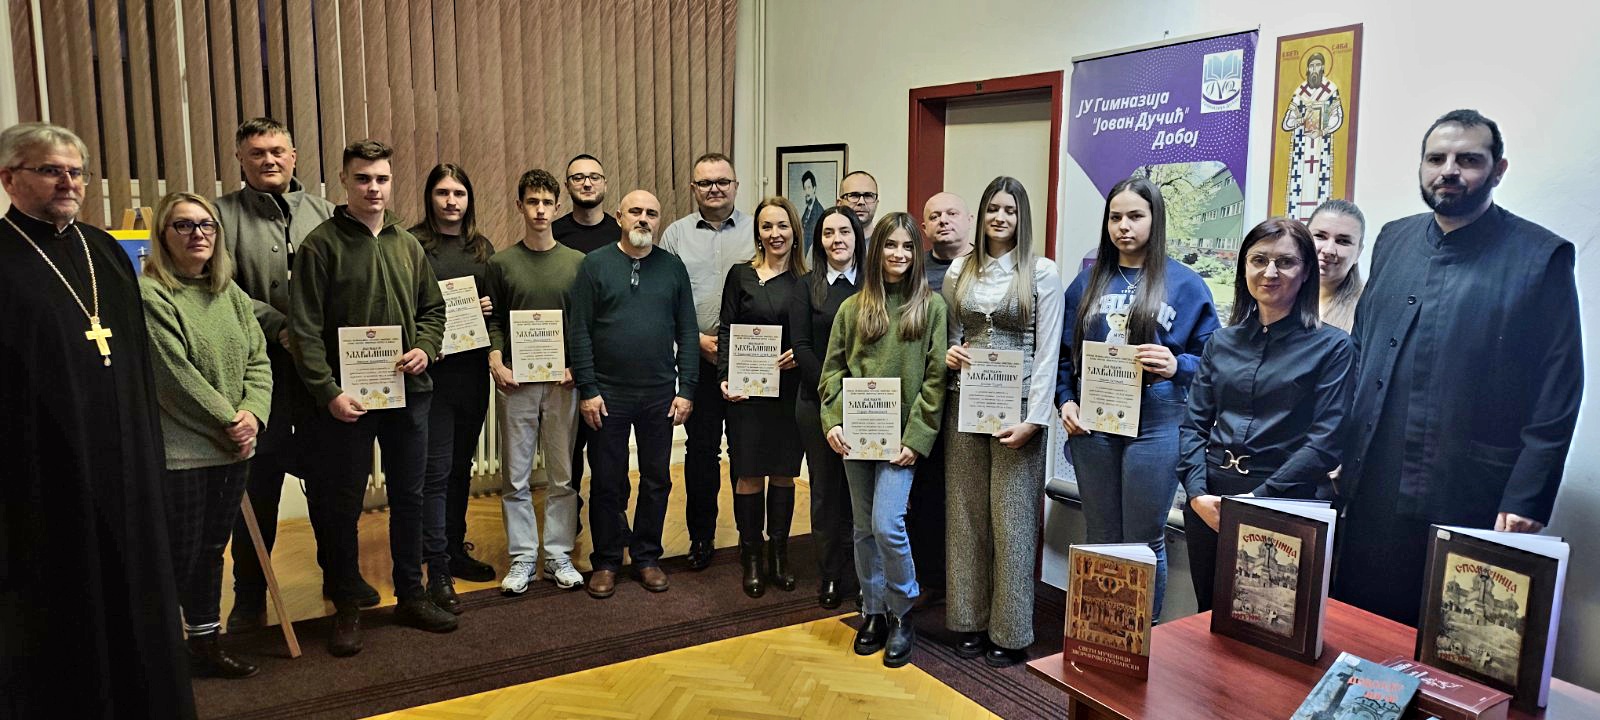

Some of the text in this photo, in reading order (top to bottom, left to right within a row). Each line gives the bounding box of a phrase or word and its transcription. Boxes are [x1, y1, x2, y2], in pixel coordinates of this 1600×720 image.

[1076, 91, 1170, 118] ЈУ Гимназија
[1092, 107, 1190, 136] "Јован Дучић"
[1151, 128, 1200, 151] Добој
